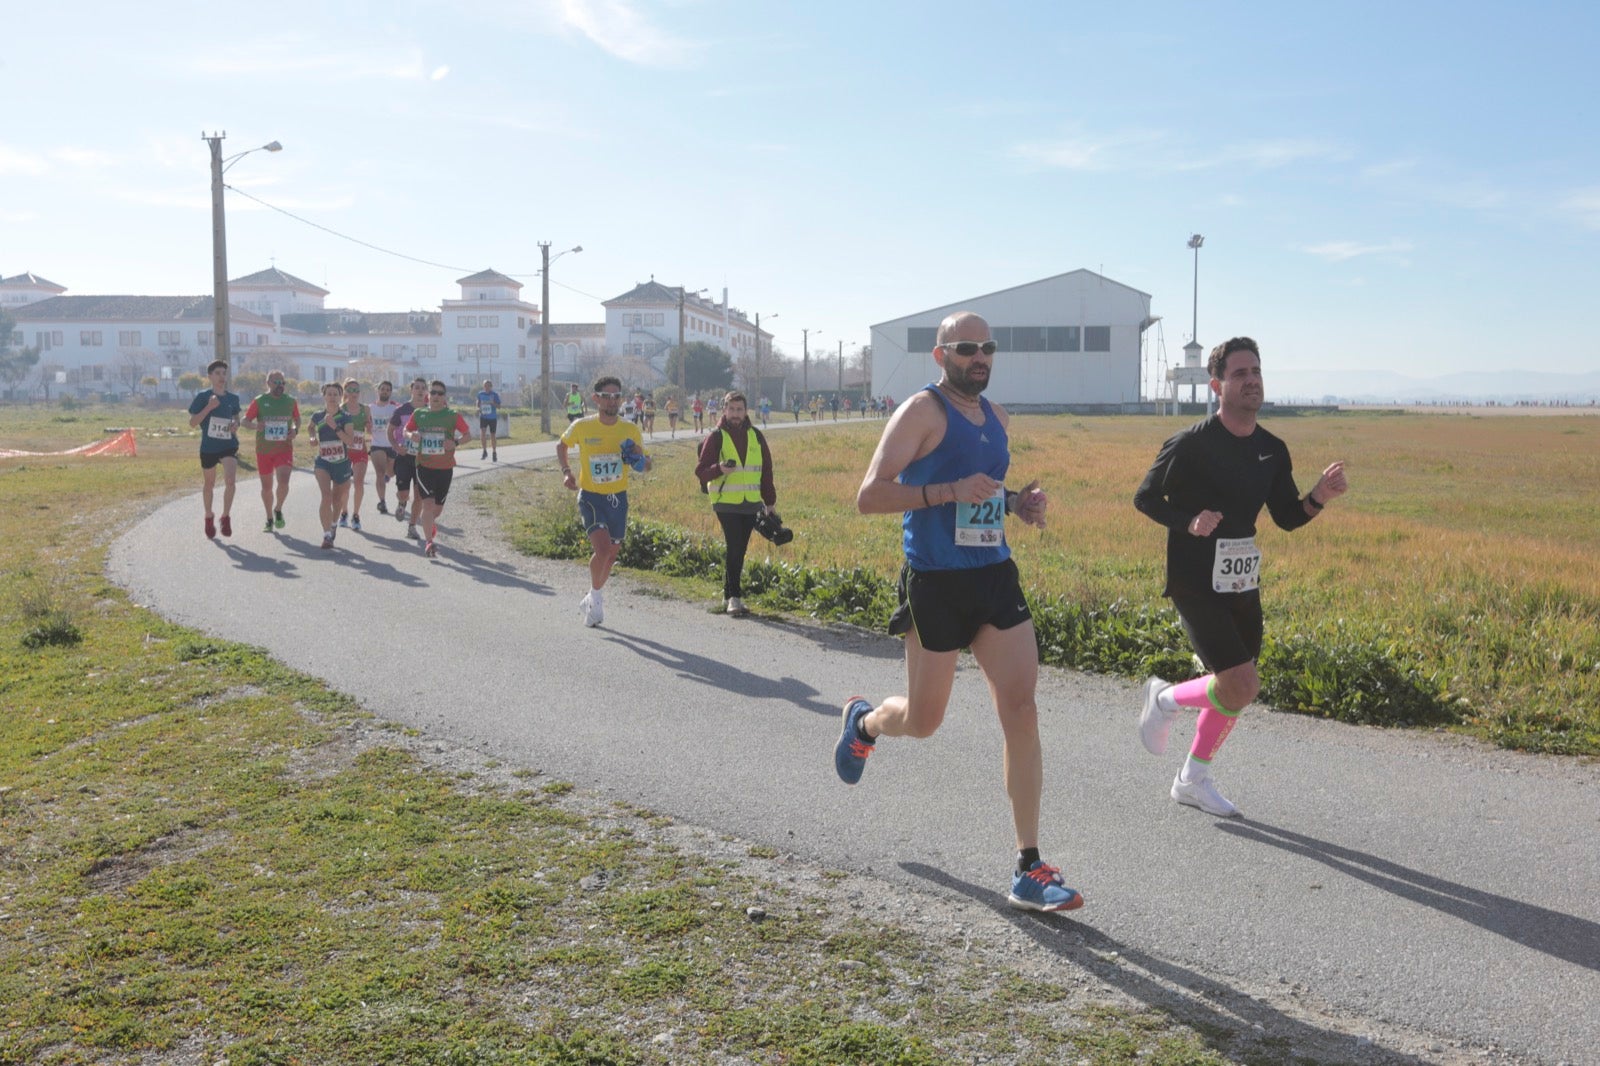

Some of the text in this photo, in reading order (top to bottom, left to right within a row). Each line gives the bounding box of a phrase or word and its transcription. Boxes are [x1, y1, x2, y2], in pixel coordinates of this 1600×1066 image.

[268, 427, 285, 435] 472
[594, 463, 618, 475] 517
[969, 502, 1001, 524] 224
[1220, 556, 1259, 575] 3087
